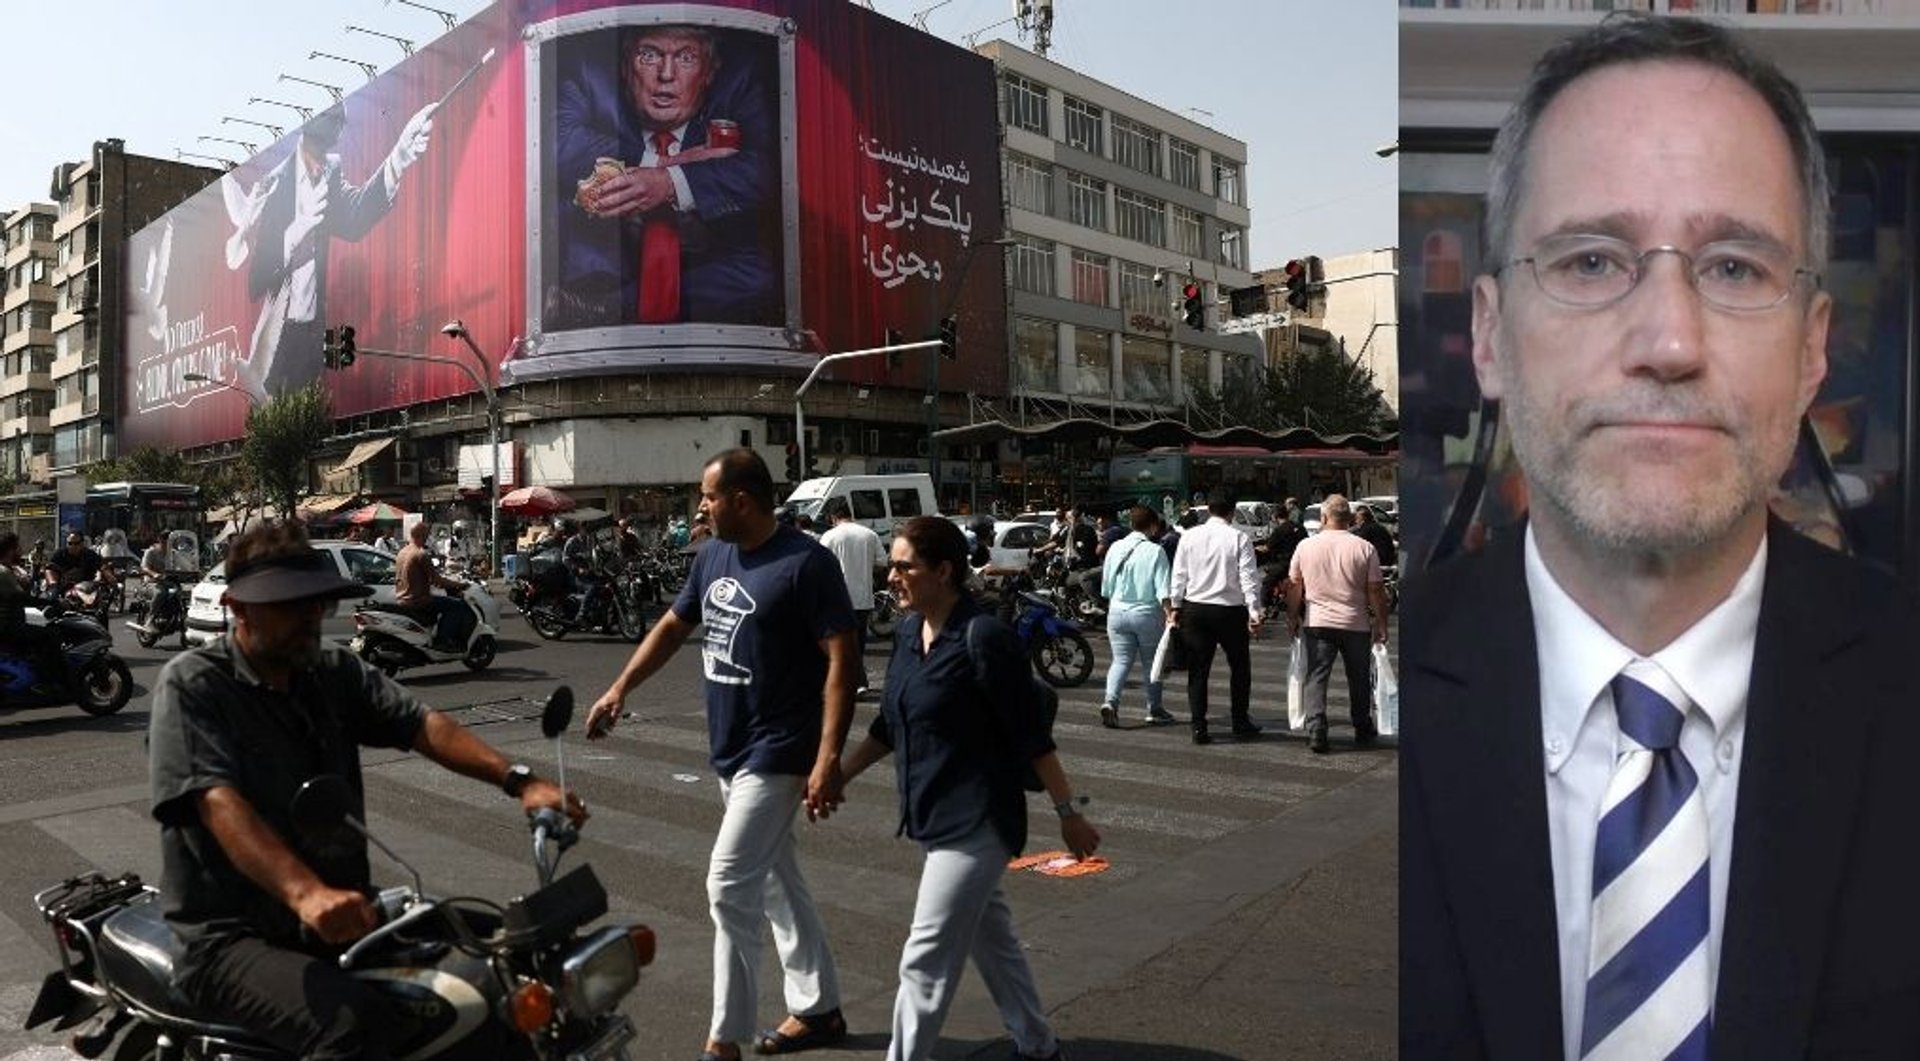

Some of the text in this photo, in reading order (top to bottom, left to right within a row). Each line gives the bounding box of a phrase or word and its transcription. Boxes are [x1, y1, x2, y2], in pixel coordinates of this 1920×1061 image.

[919, 157, 971, 185] شعبده
[862, 178, 972, 247] پلک بزنی
[862, 234, 942, 289] محوی!
